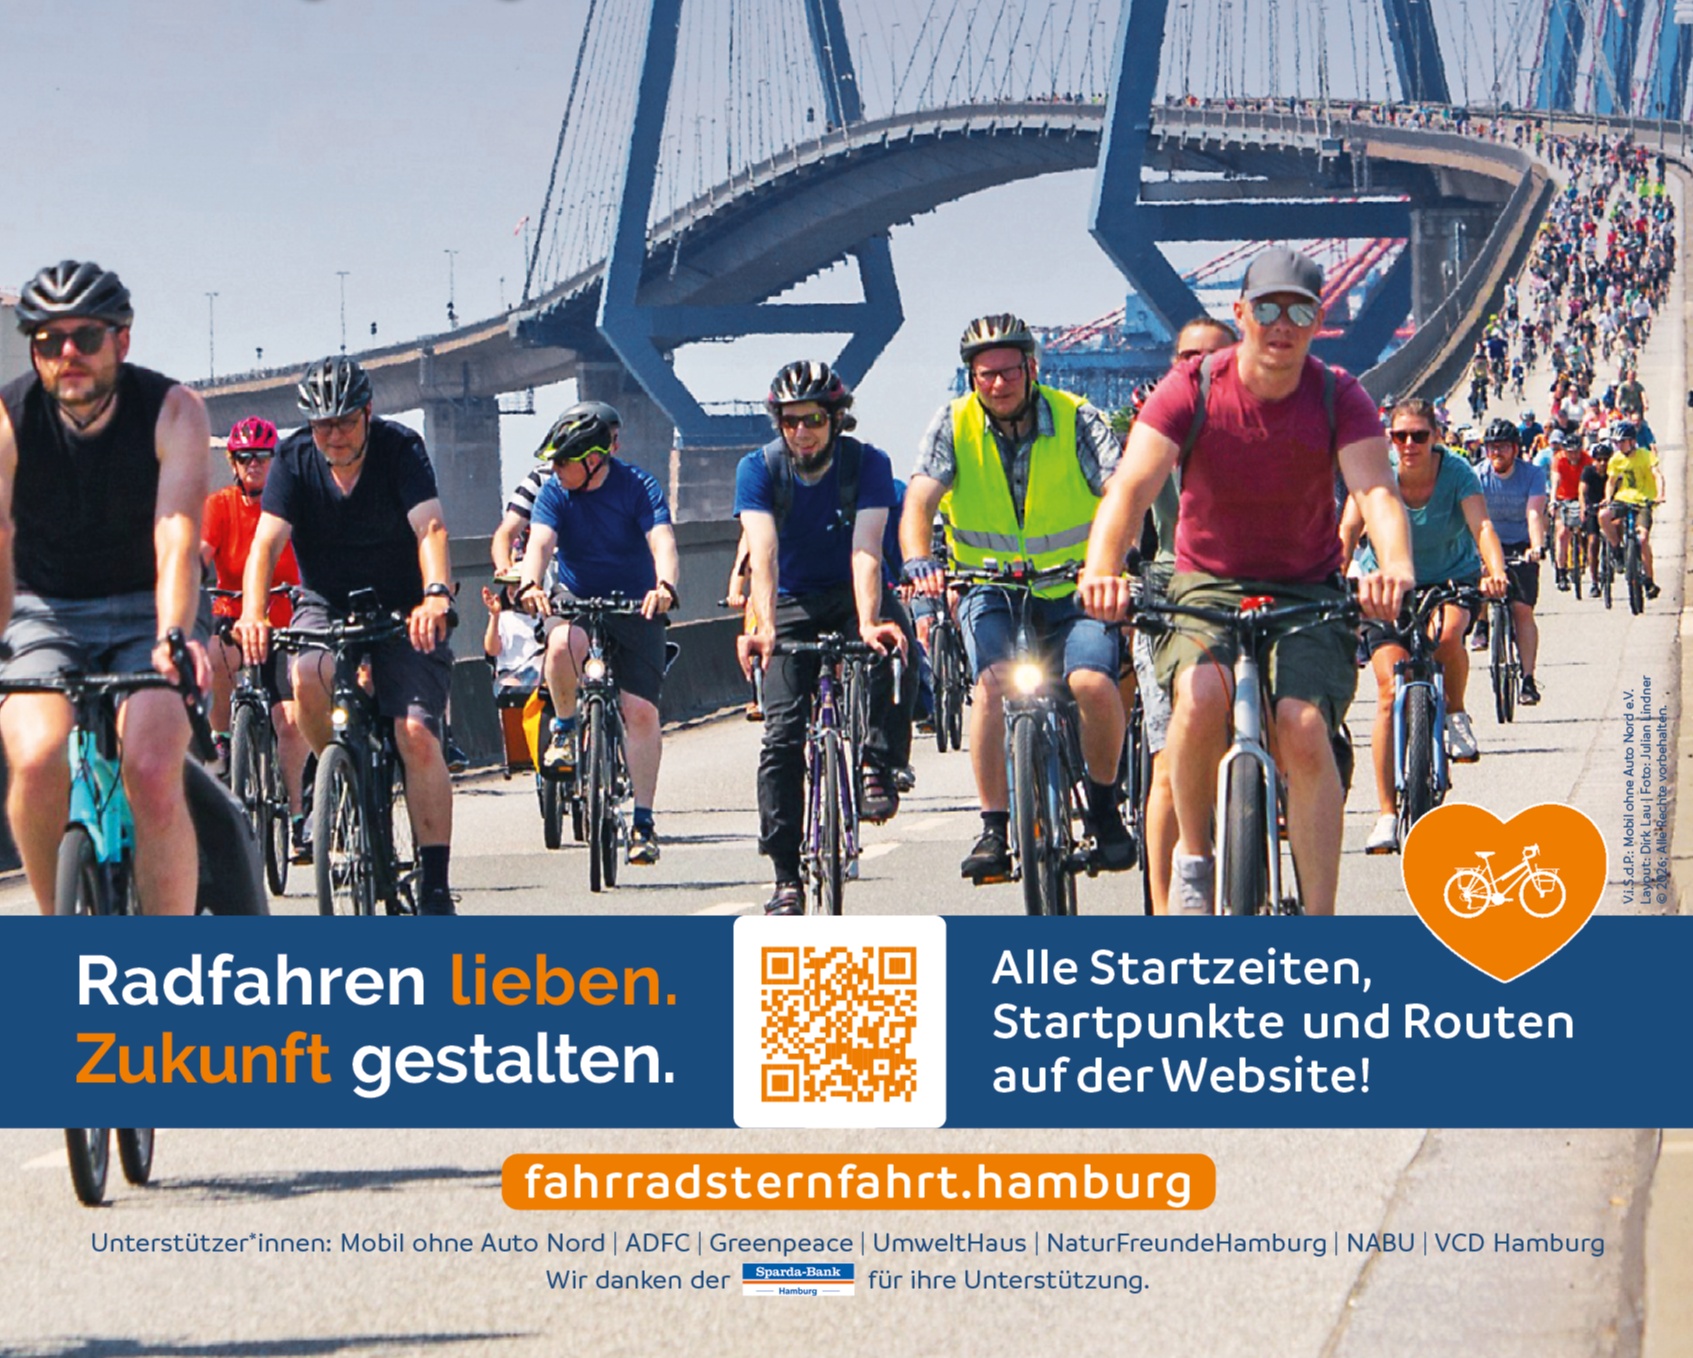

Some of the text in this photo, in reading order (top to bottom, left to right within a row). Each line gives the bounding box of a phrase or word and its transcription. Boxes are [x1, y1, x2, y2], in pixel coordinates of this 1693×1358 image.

[1623, 689, 1635, 710] e.V.
[1623, 714, 1635, 743] Nord
[1656, 704, 1668, 783] vorbehalten.
[1623, 746, 1635, 777] Auto
[1623, 780, 1635, 812] ohne
[1640, 675, 1653, 905] Layout: Dirk Lau Foto: Julian Lindner
[1656, 786, 1668, 828] Rechte
[1623, 814, 1635, 848] Mobil
[1656, 831, 1668, 855] Alle
[79, 952, 677, 1007] Radfahren lieben.
[991, 946, 1372, 993] Alle Startzeiten,
[993, 1002, 1574, 1050] Startpunkte und Routen
[76, 1030, 674, 1099] Zukunft gestalten.
[992, 1054, 1370, 1094] auf der Website!
[525, 1164, 1191, 1208] fahrradsternfahrt.hamburg
[341, 1232, 404, 1253] Mobil
[412, 1232, 474, 1253] ohne
[480, 1232, 539, 1253] Auto
[547, 1232, 605, 1253] Nord
[625, 1232, 690, 1253] ADFC
[709, 1232, 854, 1257] Greenpeace
[873, 1232, 1027, 1253] UmweltHaus
[1047, 1232, 1327, 1258] NaturFreundeHamburg
[1347, 1232, 1415, 1253] NABU
[1434, 1232, 1485, 1253] VCD
[1494, 1232, 1605, 1258] Hamburg
[545, 1269, 731, 1290] Wir danken der
[755, 1266, 841, 1280] Sparda-Bank
[868, 1269, 1149, 1295] für ihre Unterstützung.
[778, 1287, 818, 1297] Hamburg
